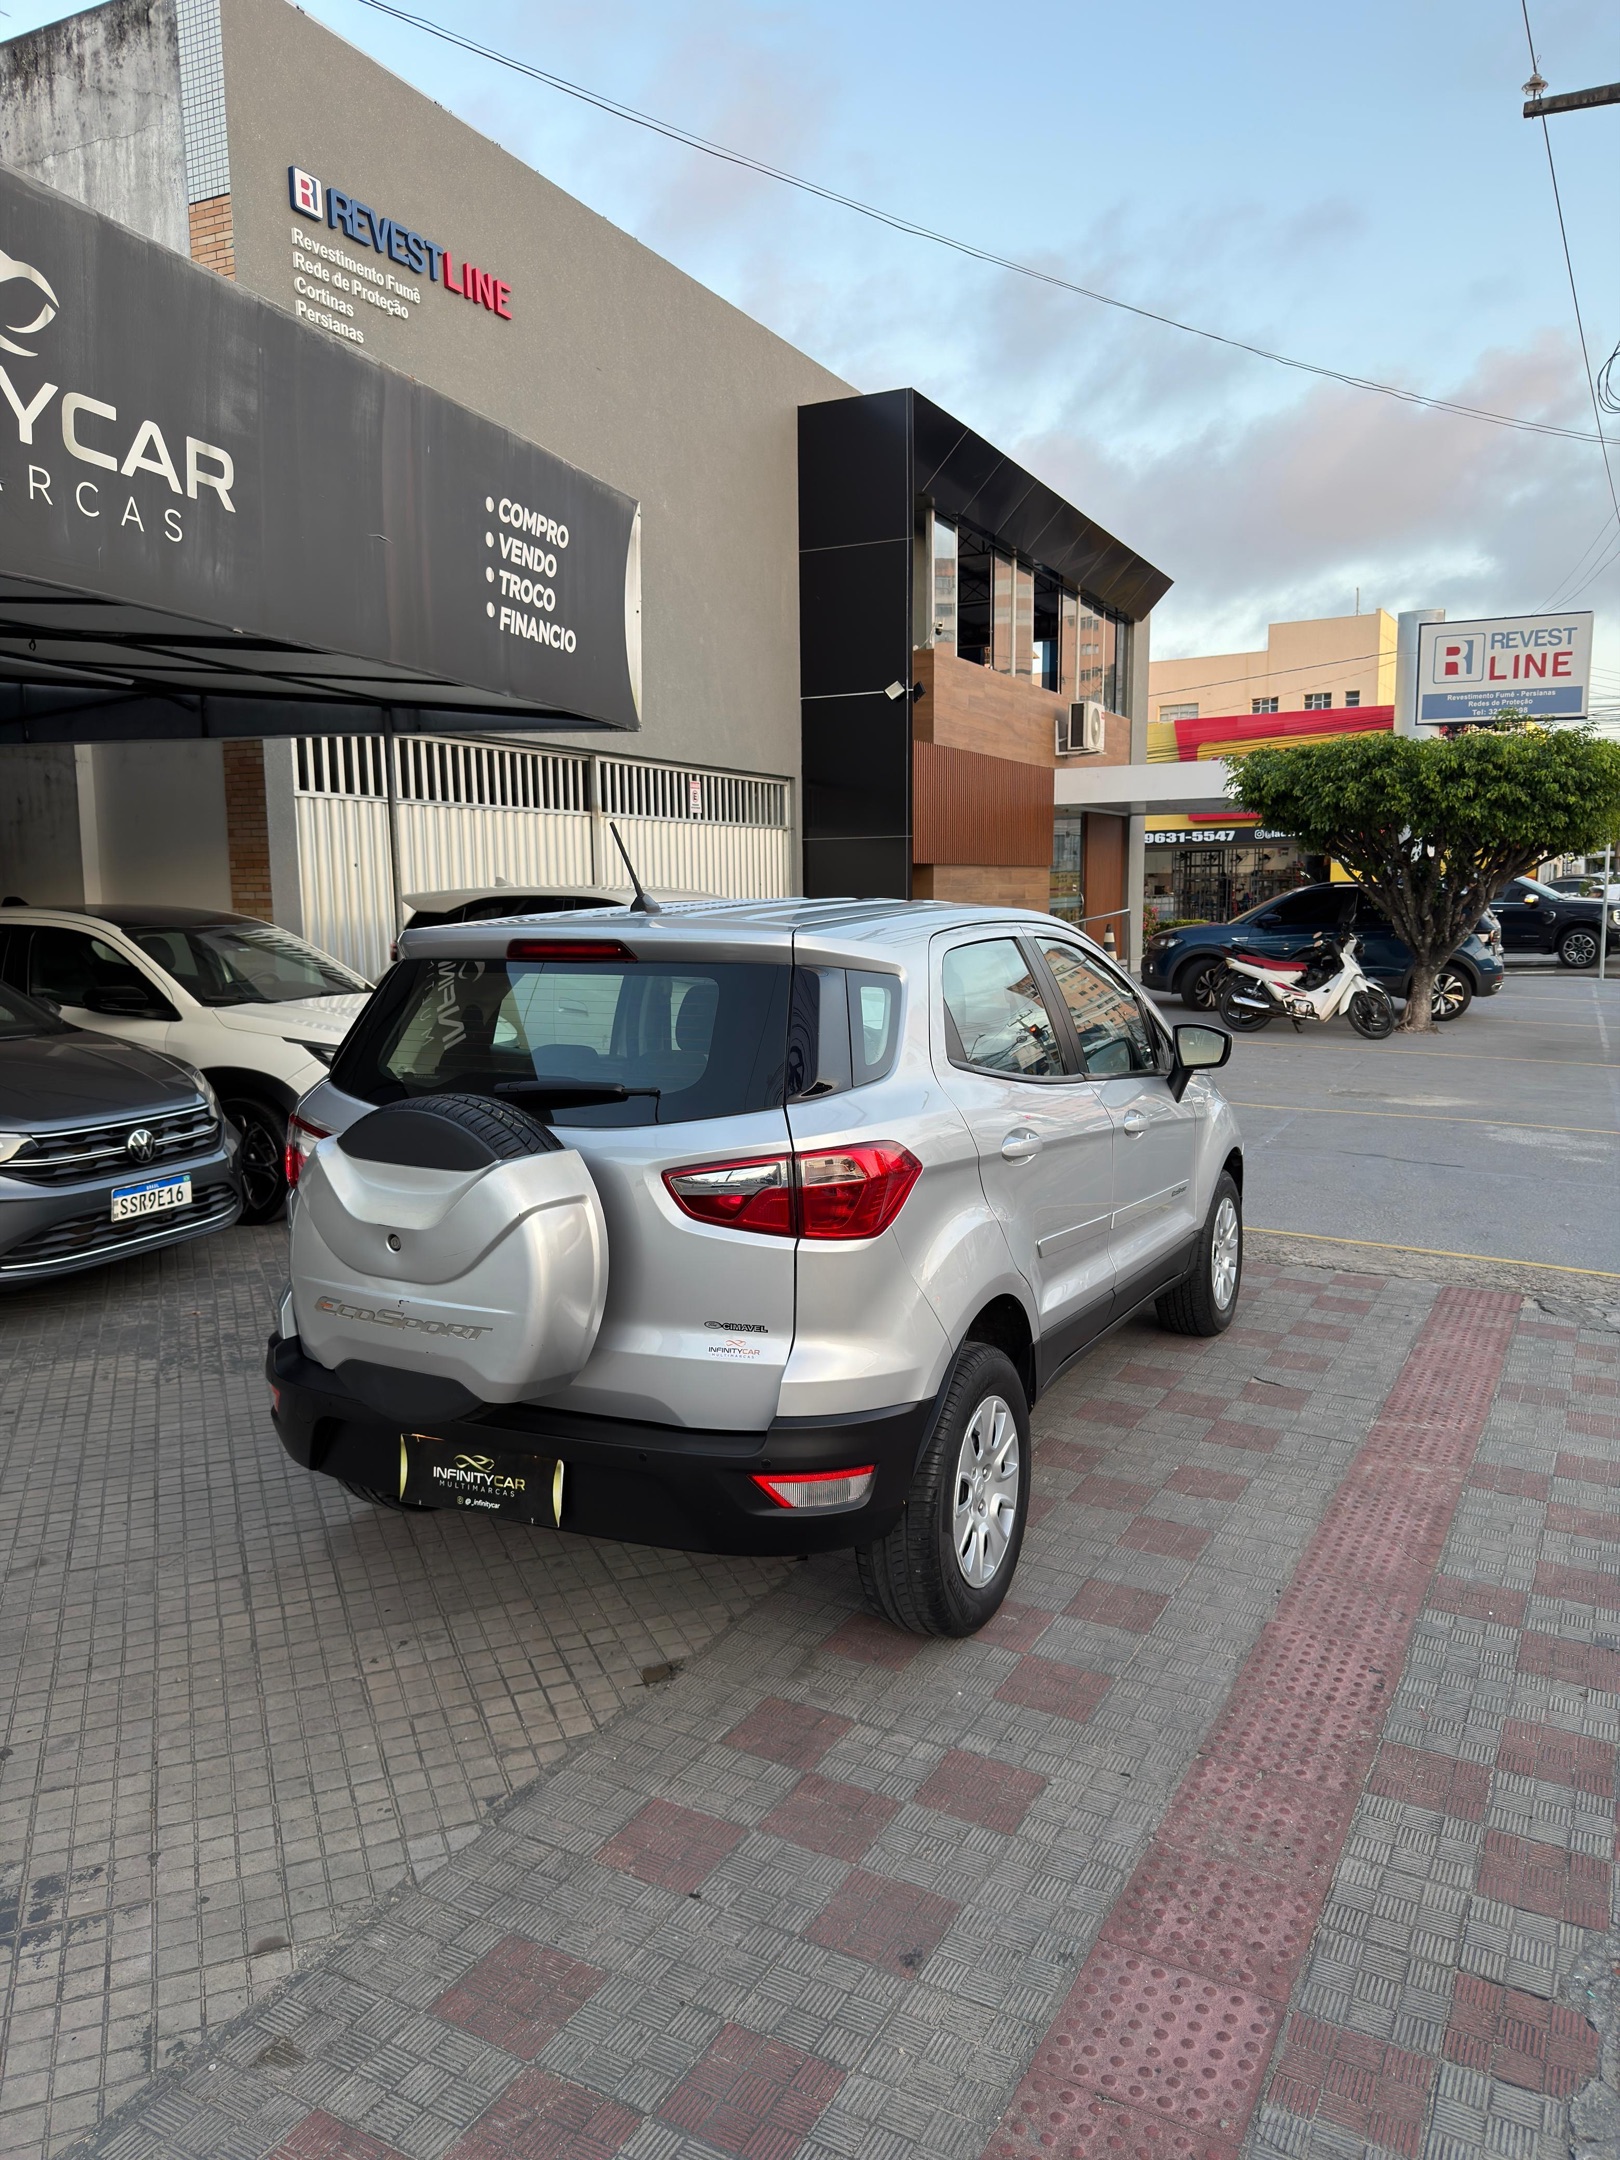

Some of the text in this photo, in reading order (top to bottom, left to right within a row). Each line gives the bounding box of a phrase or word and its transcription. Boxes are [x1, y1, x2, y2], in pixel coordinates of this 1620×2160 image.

[291, 227, 421, 304] Revestimento Fumê
[292, 251, 409, 320] Rede de Proteção
[293, 276, 354, 318] Cortinas
[295, 299, 364, 344] Persianas
[0, 464, 183, 542] RCAS
[498, 498, 570, 549] COMPRO
[499, 532, 558, 578] VENDO
[499, 569, 556, 612] TROCO
[499, 606, 577, 653] FINANCIO
[1490, 627, 1578, 650] REVEST
[1488, 651, 1573, 681] LINE
[1447, 693, 1494, 701] Revestimento
[1472, 708, 1487, 716] Tel:
[1501, 698, 1534, 706] Proteção
[1144, 830, 1236, 844] 9631-5547
[120, 1185, 184, 1216] SSR9E16
[722, 1322, 768, 1333] CIMAVEL
[708, 1346, 760, 1356] INFINITYCAR
[433, 1466, 525, 1491] INFINITYCAR
[439, 1479, 515, 1498] MULTIMARCAS
